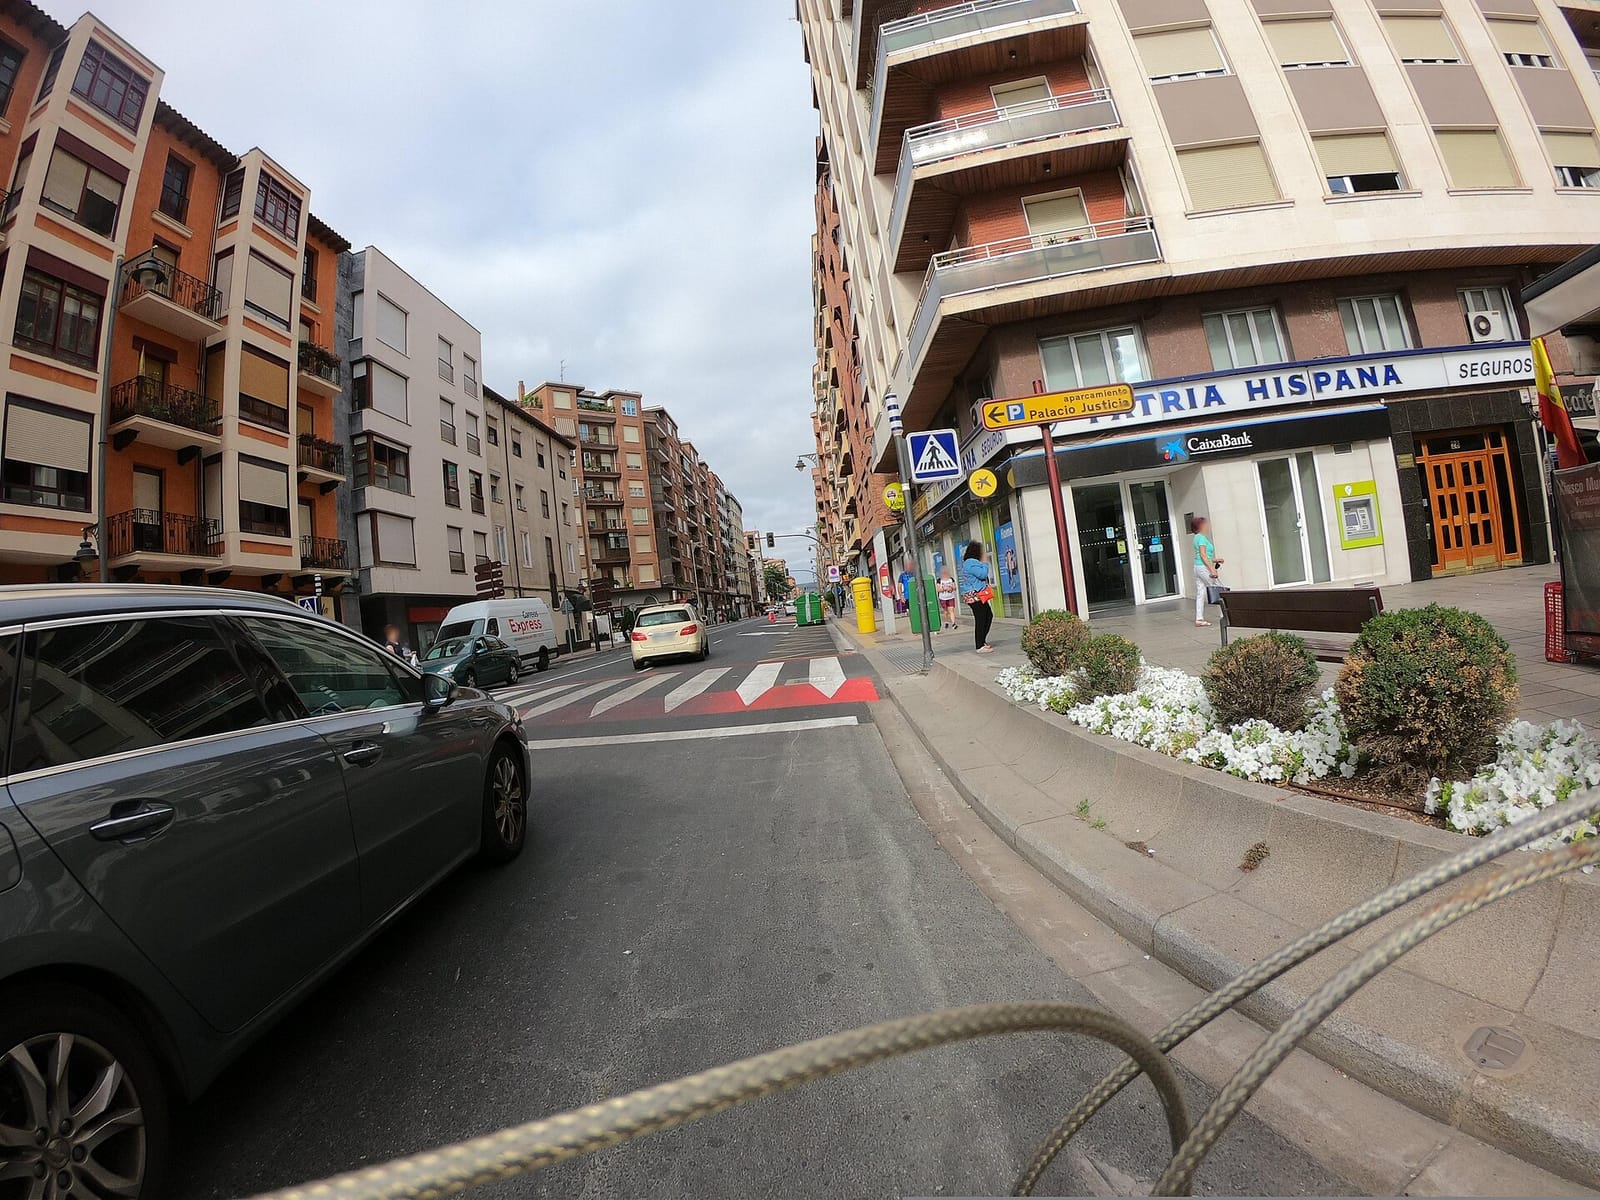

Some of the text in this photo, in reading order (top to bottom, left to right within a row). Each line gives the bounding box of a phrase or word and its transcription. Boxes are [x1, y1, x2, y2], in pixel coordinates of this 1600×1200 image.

[1063, 388, 1129, 403] aparcamiento
[1088, 358, 1533, 425] TRIA HISPANA SEGUROS
[1008, 404, 1022, 420] P
[1029, 398, 1130, 420] Palacio Justicia
[1187, 431, 1252, 453] CaixaBank
[508, 618, 543, 635] Express
